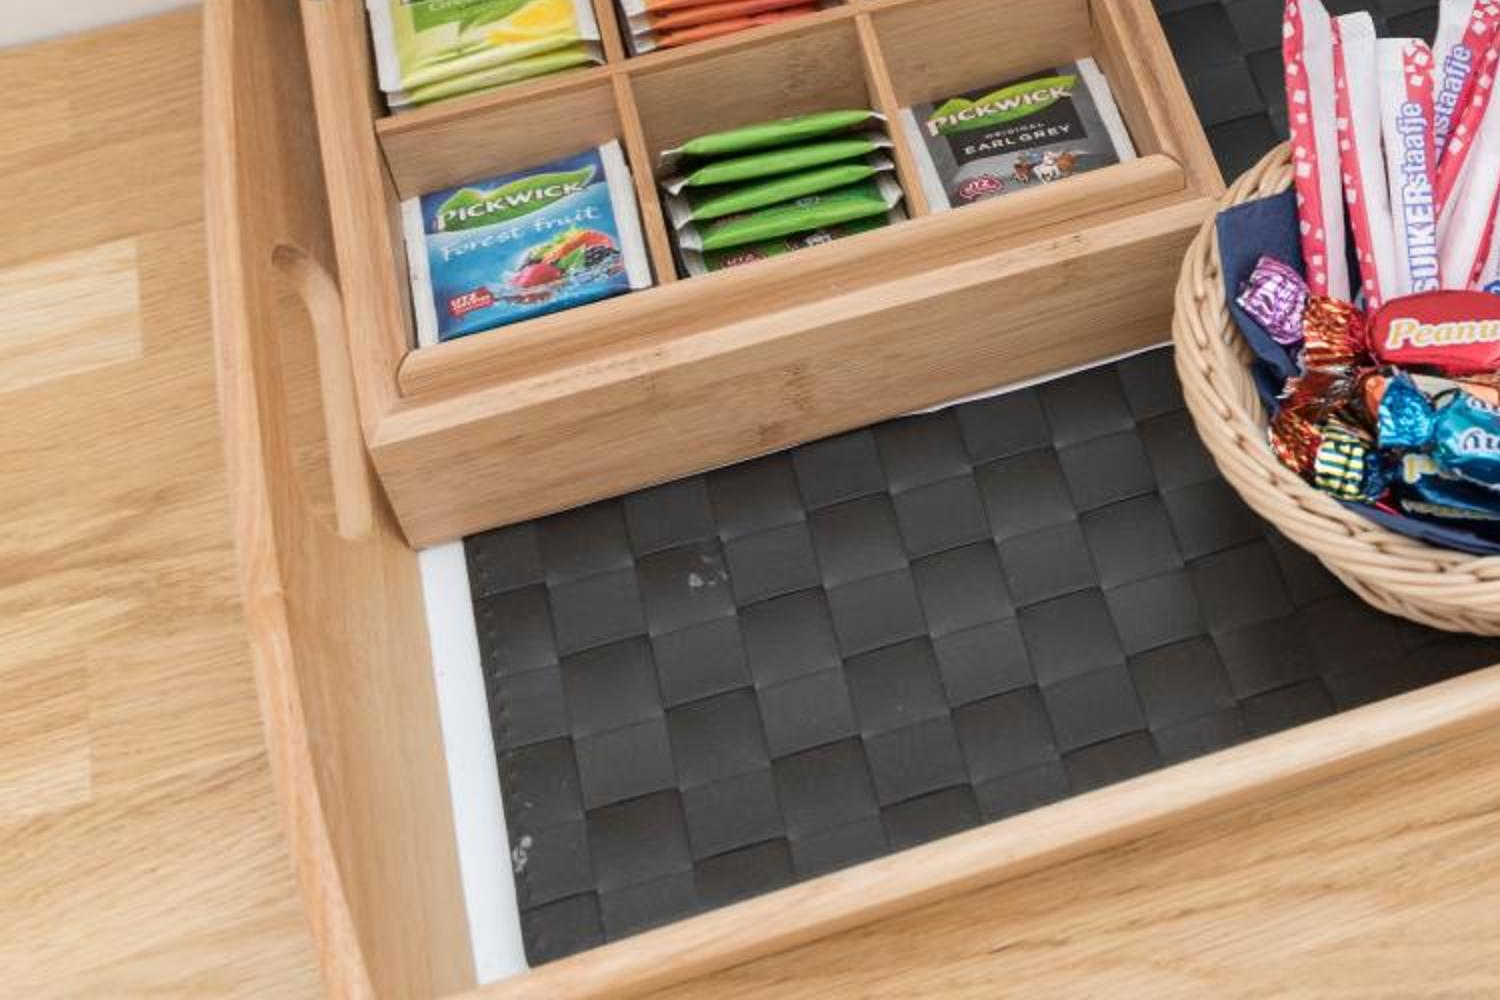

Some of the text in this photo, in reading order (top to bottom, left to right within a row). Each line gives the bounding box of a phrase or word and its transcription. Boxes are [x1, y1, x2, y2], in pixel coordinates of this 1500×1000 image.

[925, 86, 1073, 137] PICKWICK
[964, 123, 1072, 155] EARL GREY
[434, 181, 582, 231] PICKWICK
[1396, 103, 1441, 293] SUIKERstaafje
